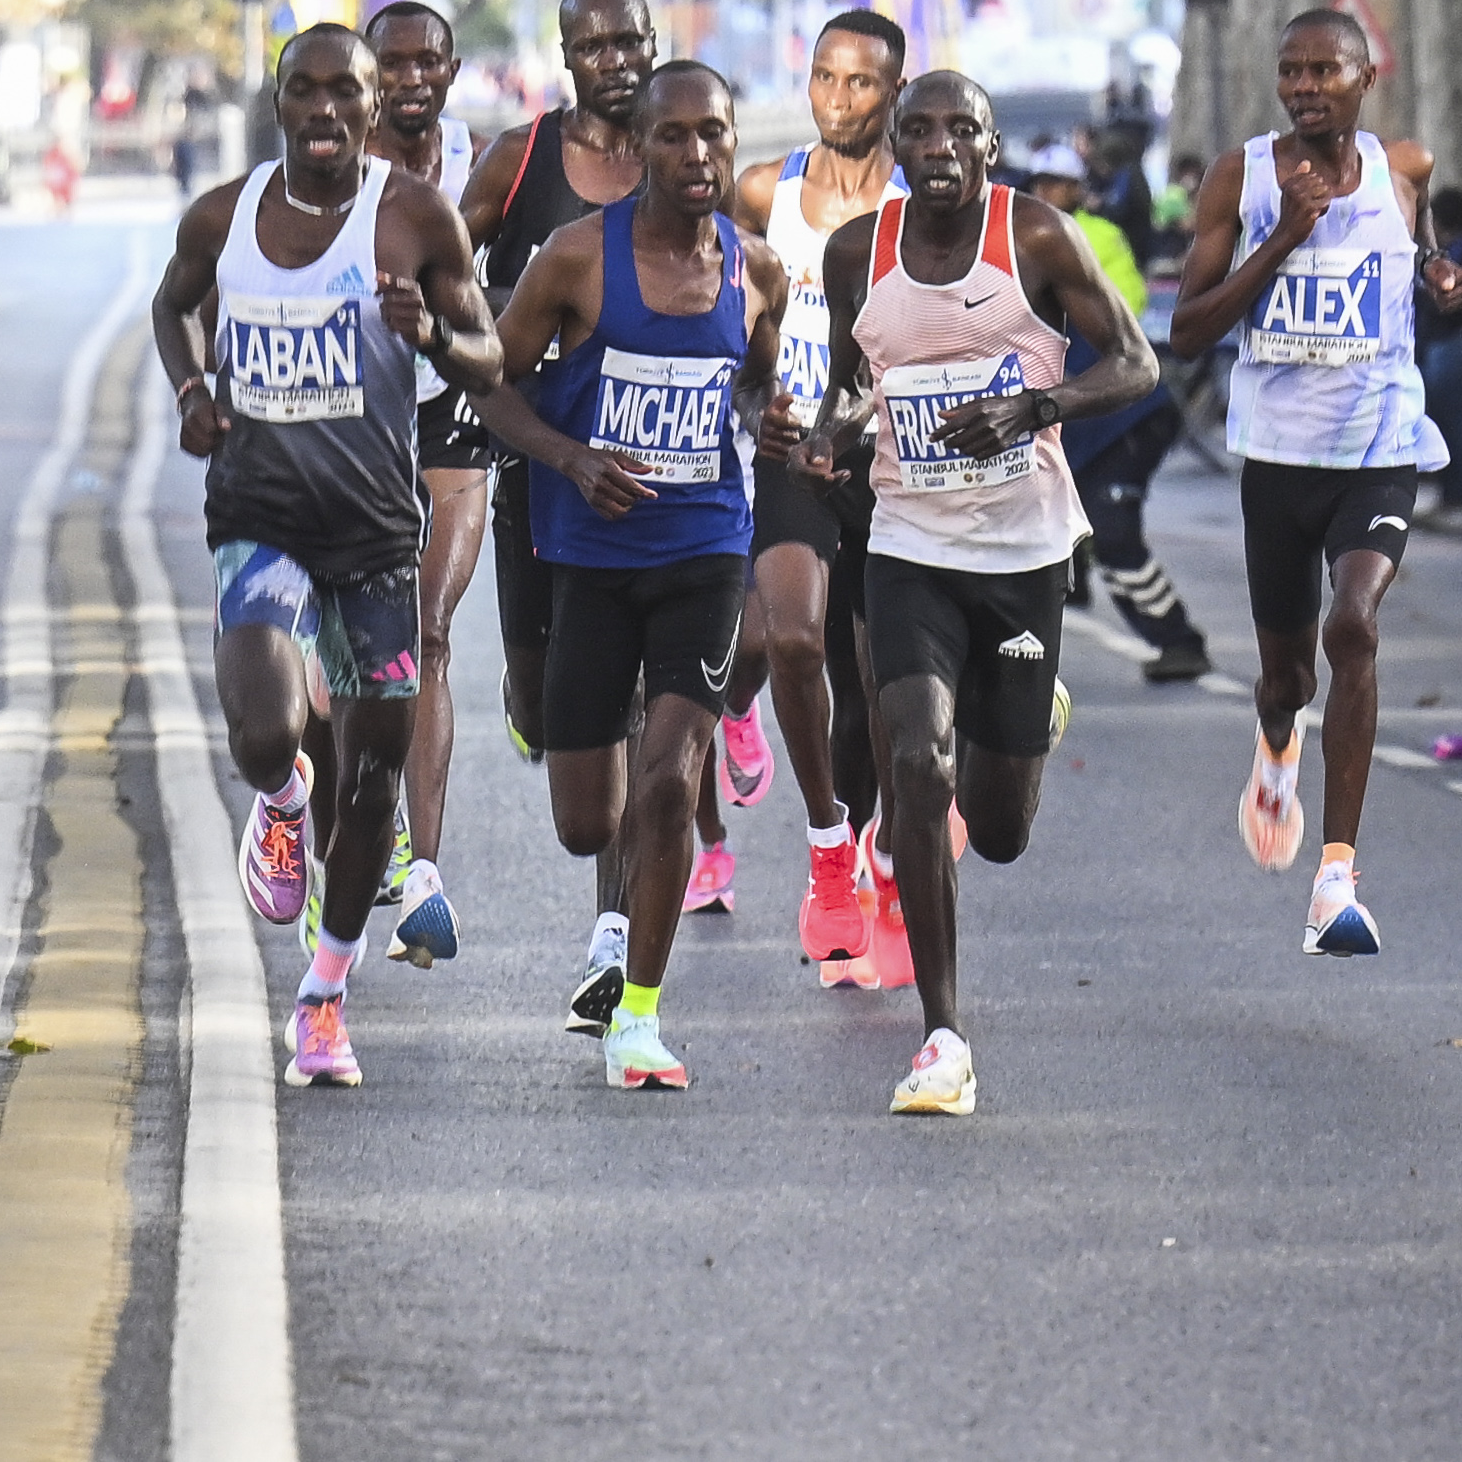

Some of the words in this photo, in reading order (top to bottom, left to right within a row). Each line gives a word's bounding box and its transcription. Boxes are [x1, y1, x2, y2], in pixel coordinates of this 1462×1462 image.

[1361, 259, 1380, 278] 11
[1262, 276, 1368, 337] ALEX
[336, 308, 358, 327] 91
[230, 318, 357, 389] LABAN
[715, 369, 731, 387] 99
[999, 364, 1021, 385] 94
[598, 379, 723, 450] MICHAEL
[960, 448, 1025, 471] MARATHON
[1004, 461, 1031, 477] 2023
